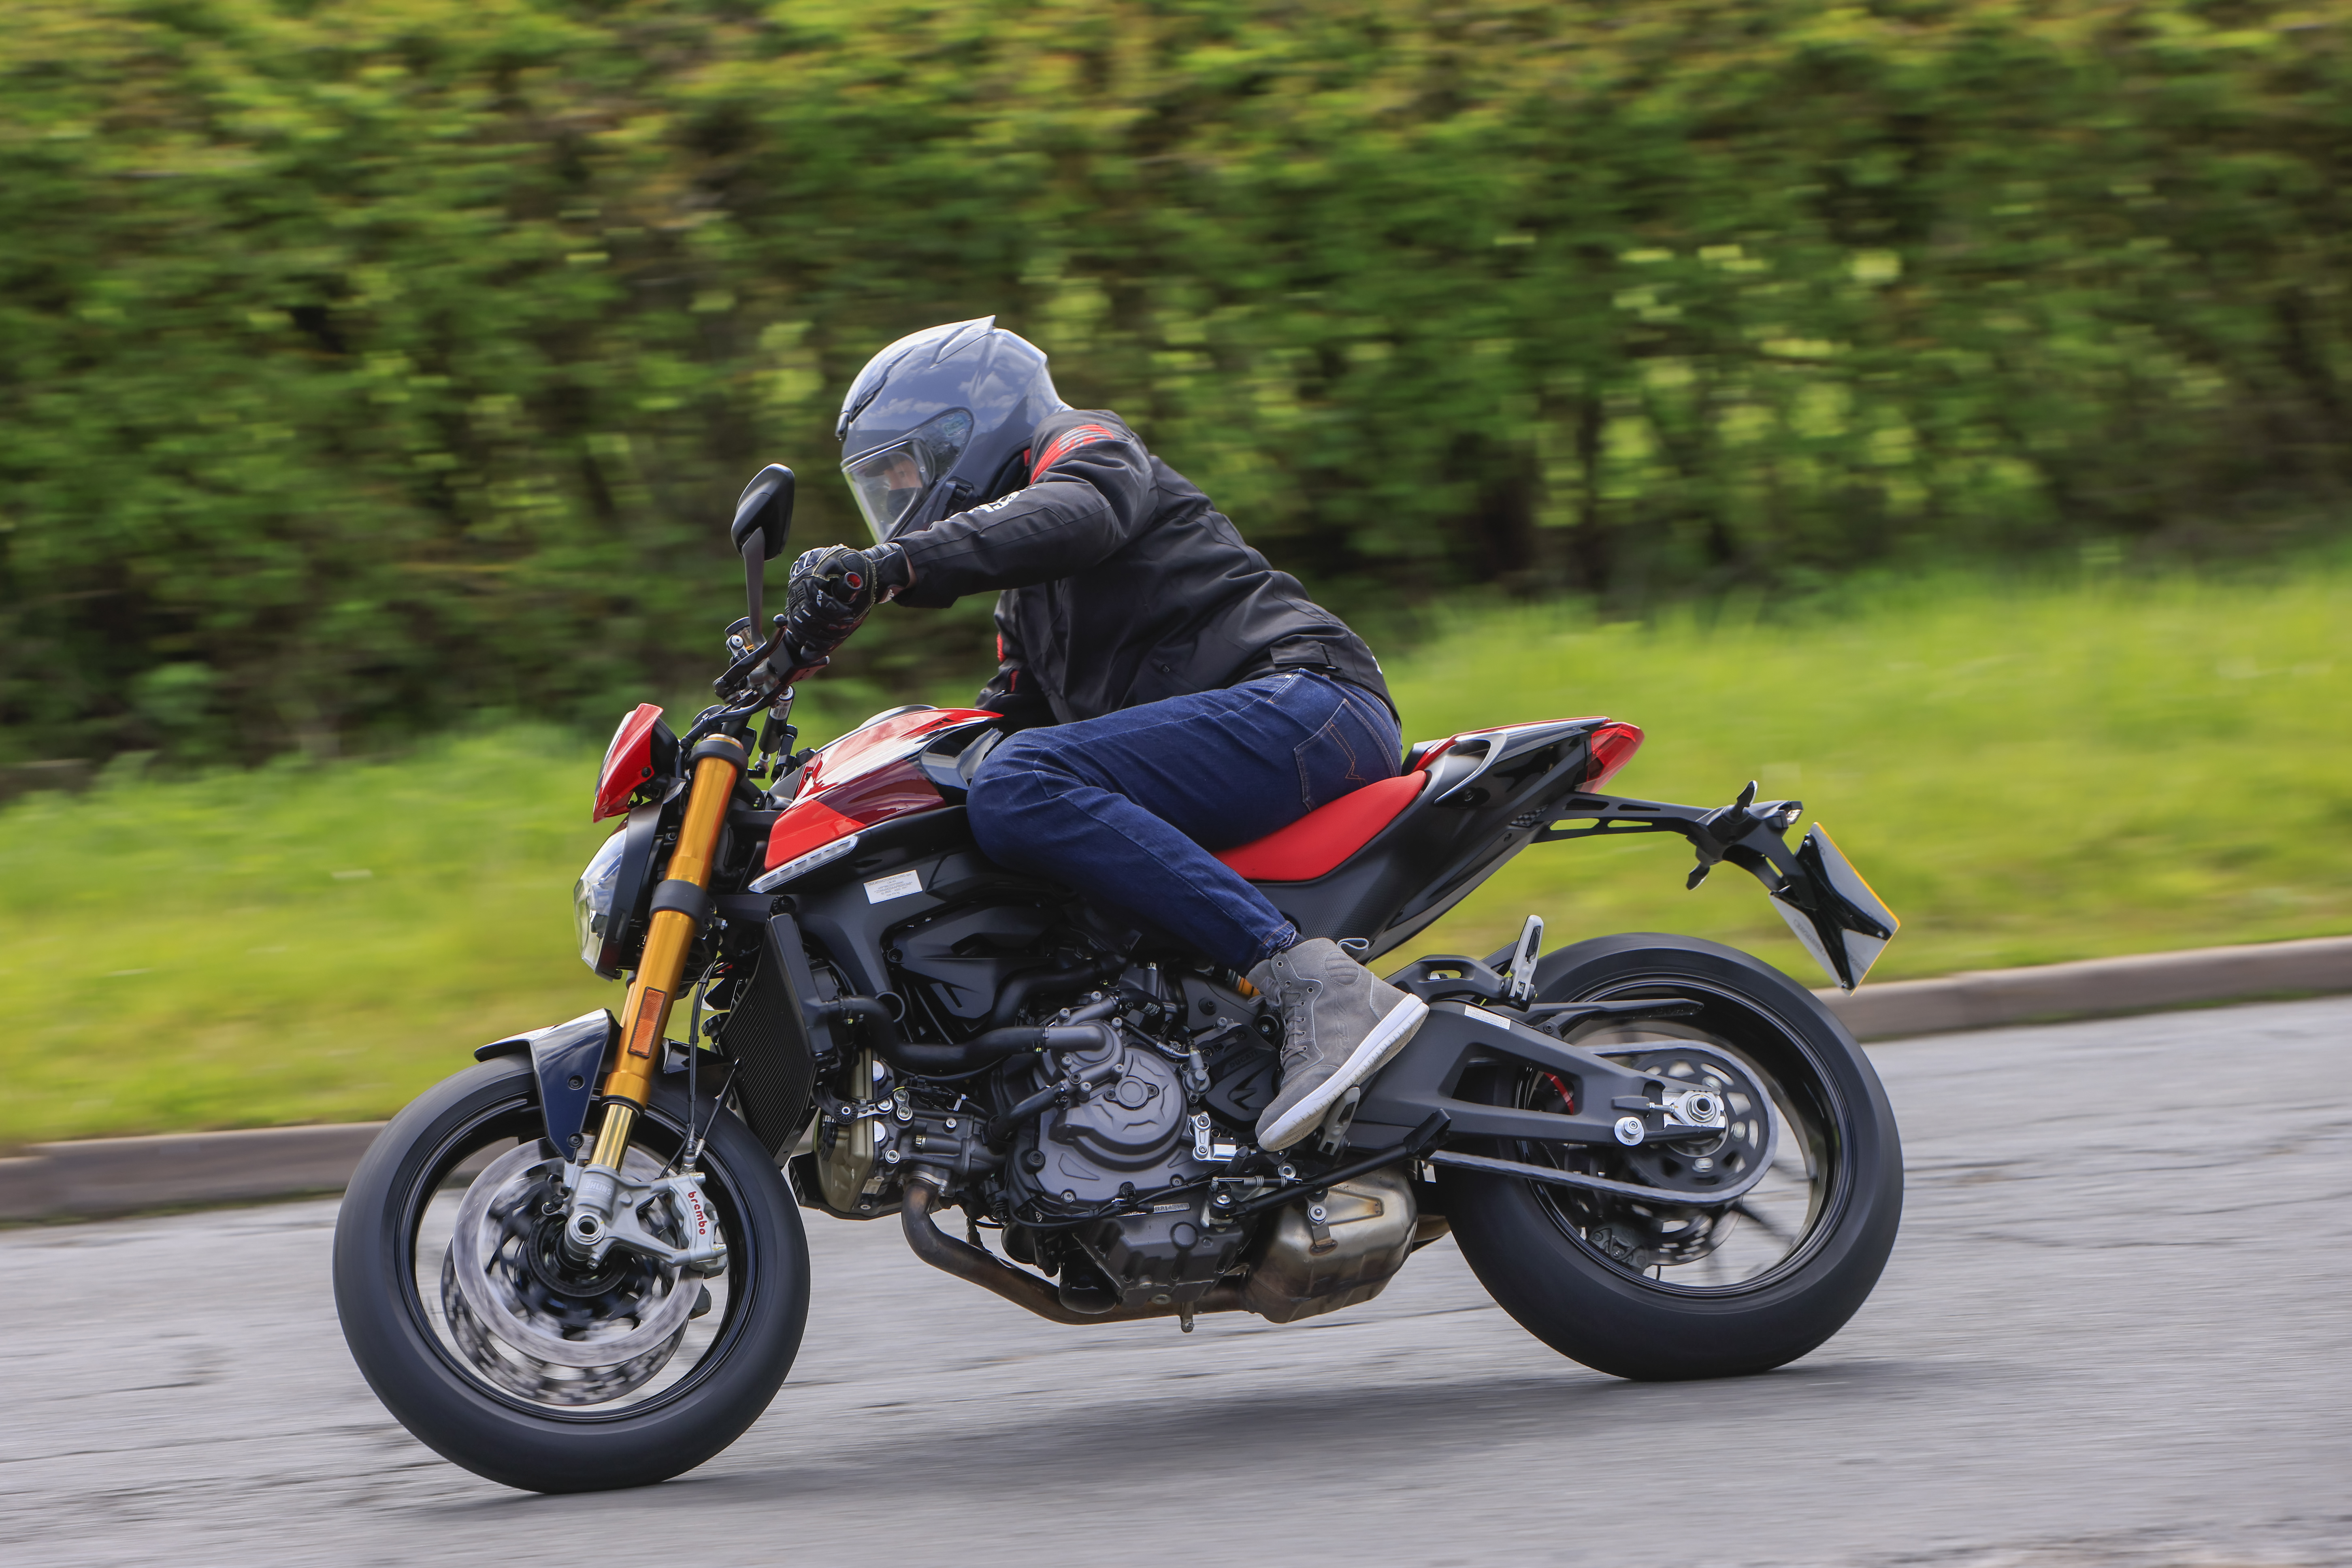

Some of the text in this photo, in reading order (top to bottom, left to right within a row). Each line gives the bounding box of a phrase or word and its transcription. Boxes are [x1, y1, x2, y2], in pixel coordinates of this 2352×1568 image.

[1229, 1050, 1258, 1068] DUCATI
[586, 1180, 612, 1195] ÖHLINS
[688, 1191, 707, 1235] brembo
